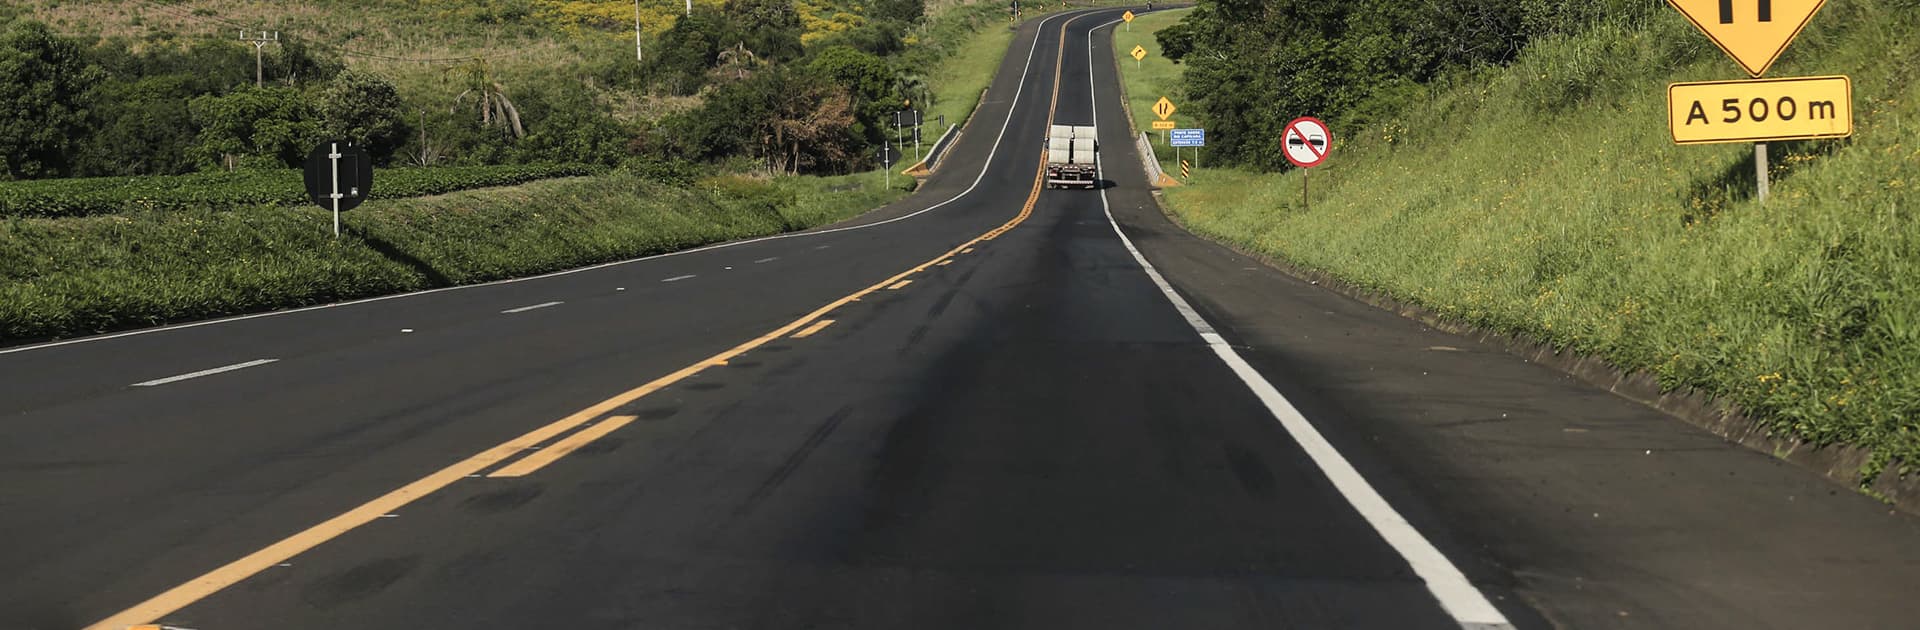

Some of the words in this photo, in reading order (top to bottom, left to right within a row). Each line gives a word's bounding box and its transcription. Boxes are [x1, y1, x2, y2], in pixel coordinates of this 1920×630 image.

[1685, 100, 1709, 126] A
[1722, 96, 1797, 124] 500
[1809, 99, 1835, 120] m
